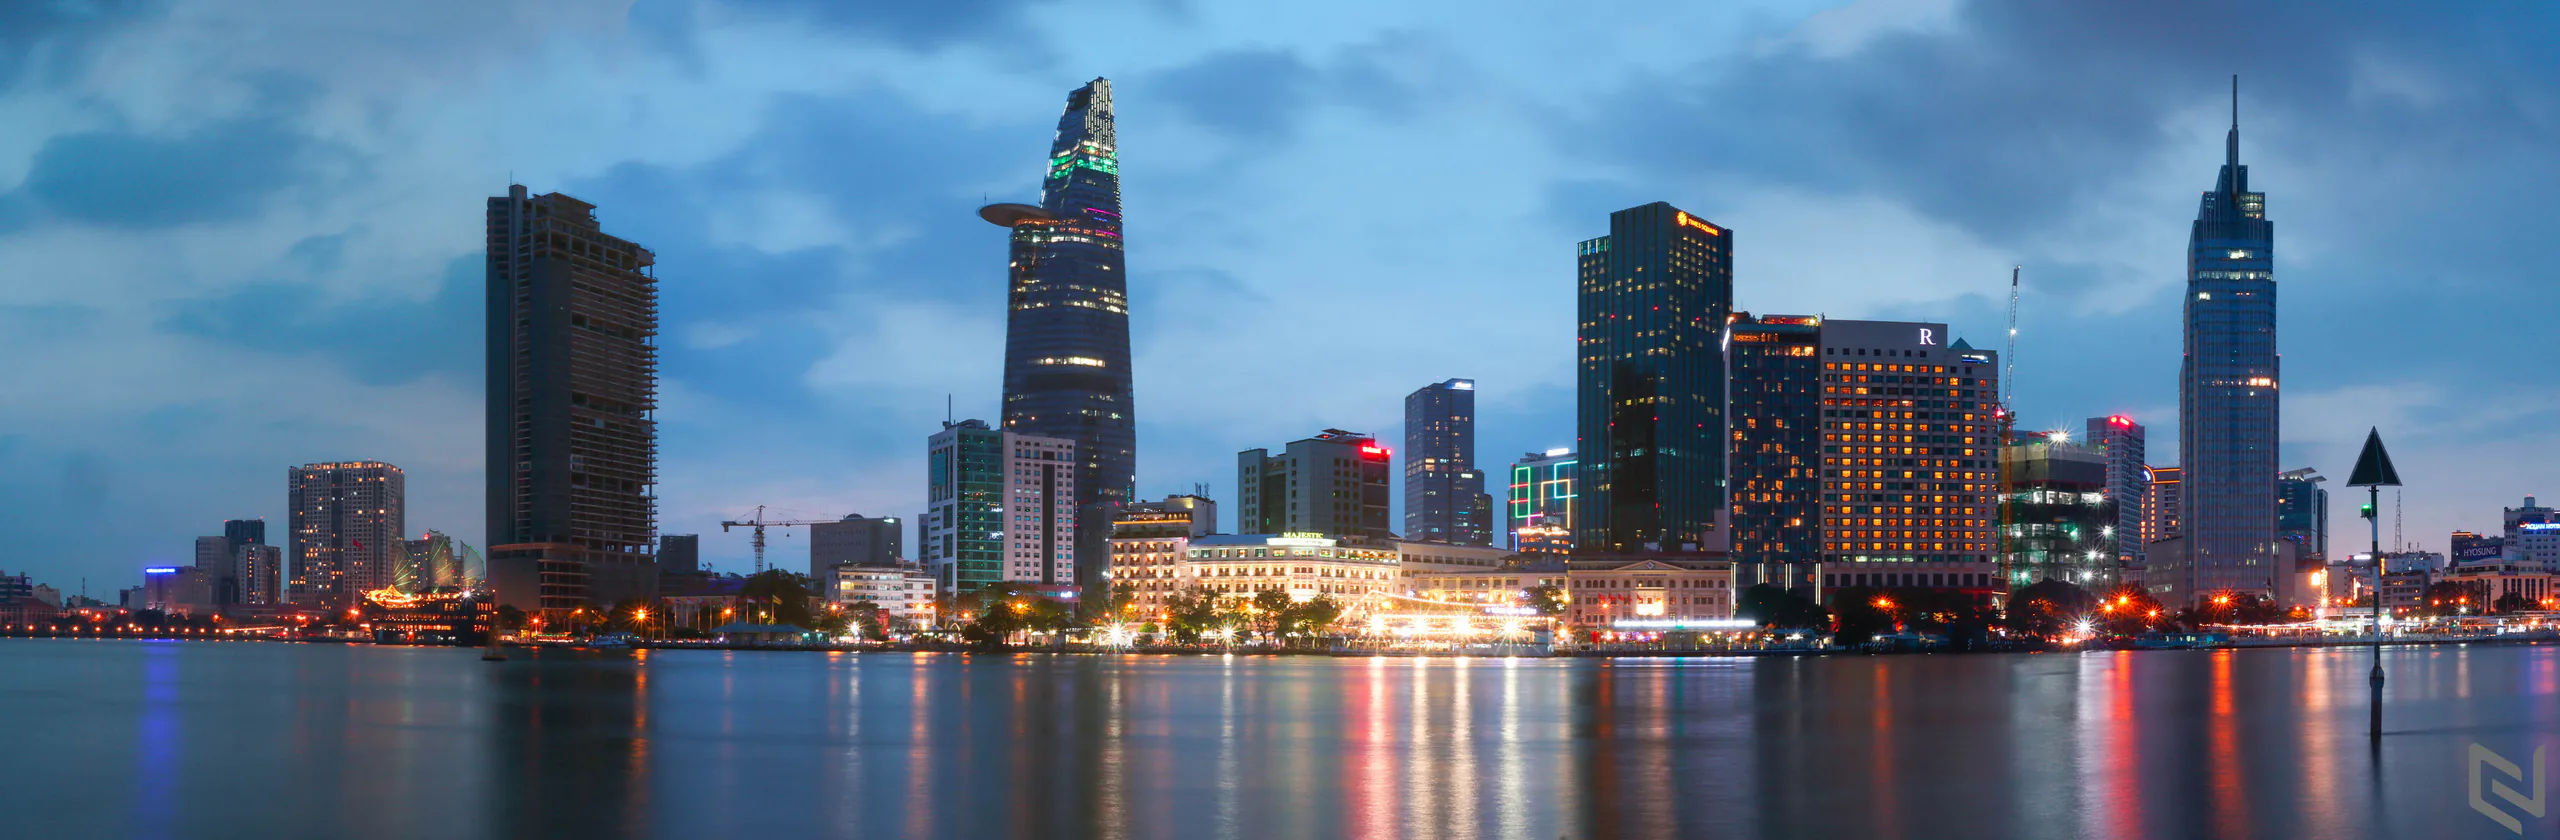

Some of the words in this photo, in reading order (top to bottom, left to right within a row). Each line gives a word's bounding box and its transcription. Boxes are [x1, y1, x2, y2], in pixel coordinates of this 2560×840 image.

[1688, 218, 1701, 229] TIMES
[1701, 224, 1718, 236] SQUARE
[1919, 328, 1936, 345] R
[1283, 531, 1324, 539] MAJESTIC
[2463, 546, 2497, 557] HYOSUNG
